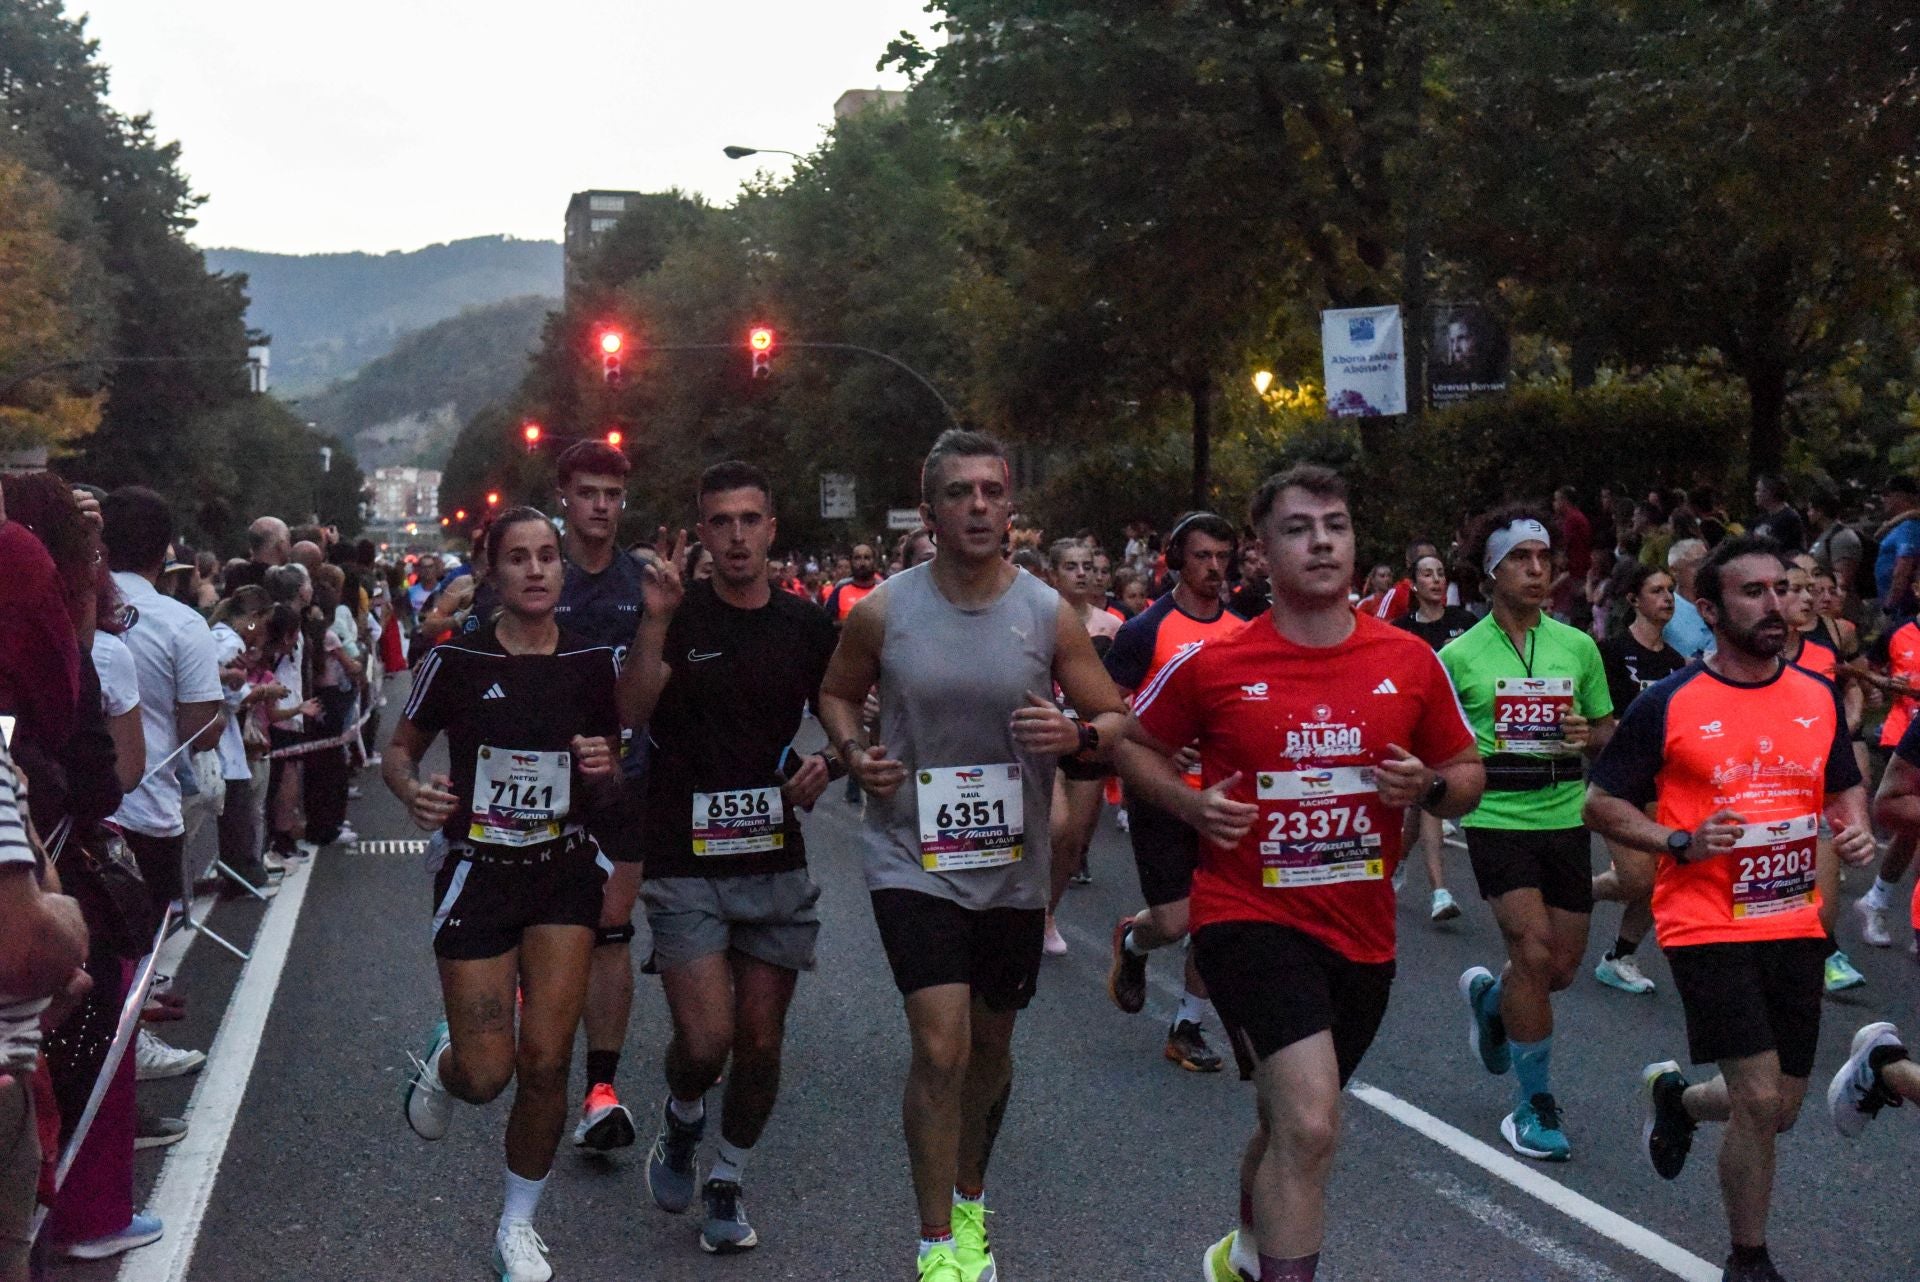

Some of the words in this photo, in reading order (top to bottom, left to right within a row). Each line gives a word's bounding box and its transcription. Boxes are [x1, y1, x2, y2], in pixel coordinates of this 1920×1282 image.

[1287, 727, 1361, 749] BILBAO
[508, 774, 538, 782] ANETXU
[490, 780, 553, 809] 7141
[707, 792, 770, 818] 6536
[1299, 798, 1338, 808] KACHOW
[936, 800, 1005, 829] 6351
[1267, 805, 1372, 841] 23376
[1739, 848, 1812, 882] 23203
